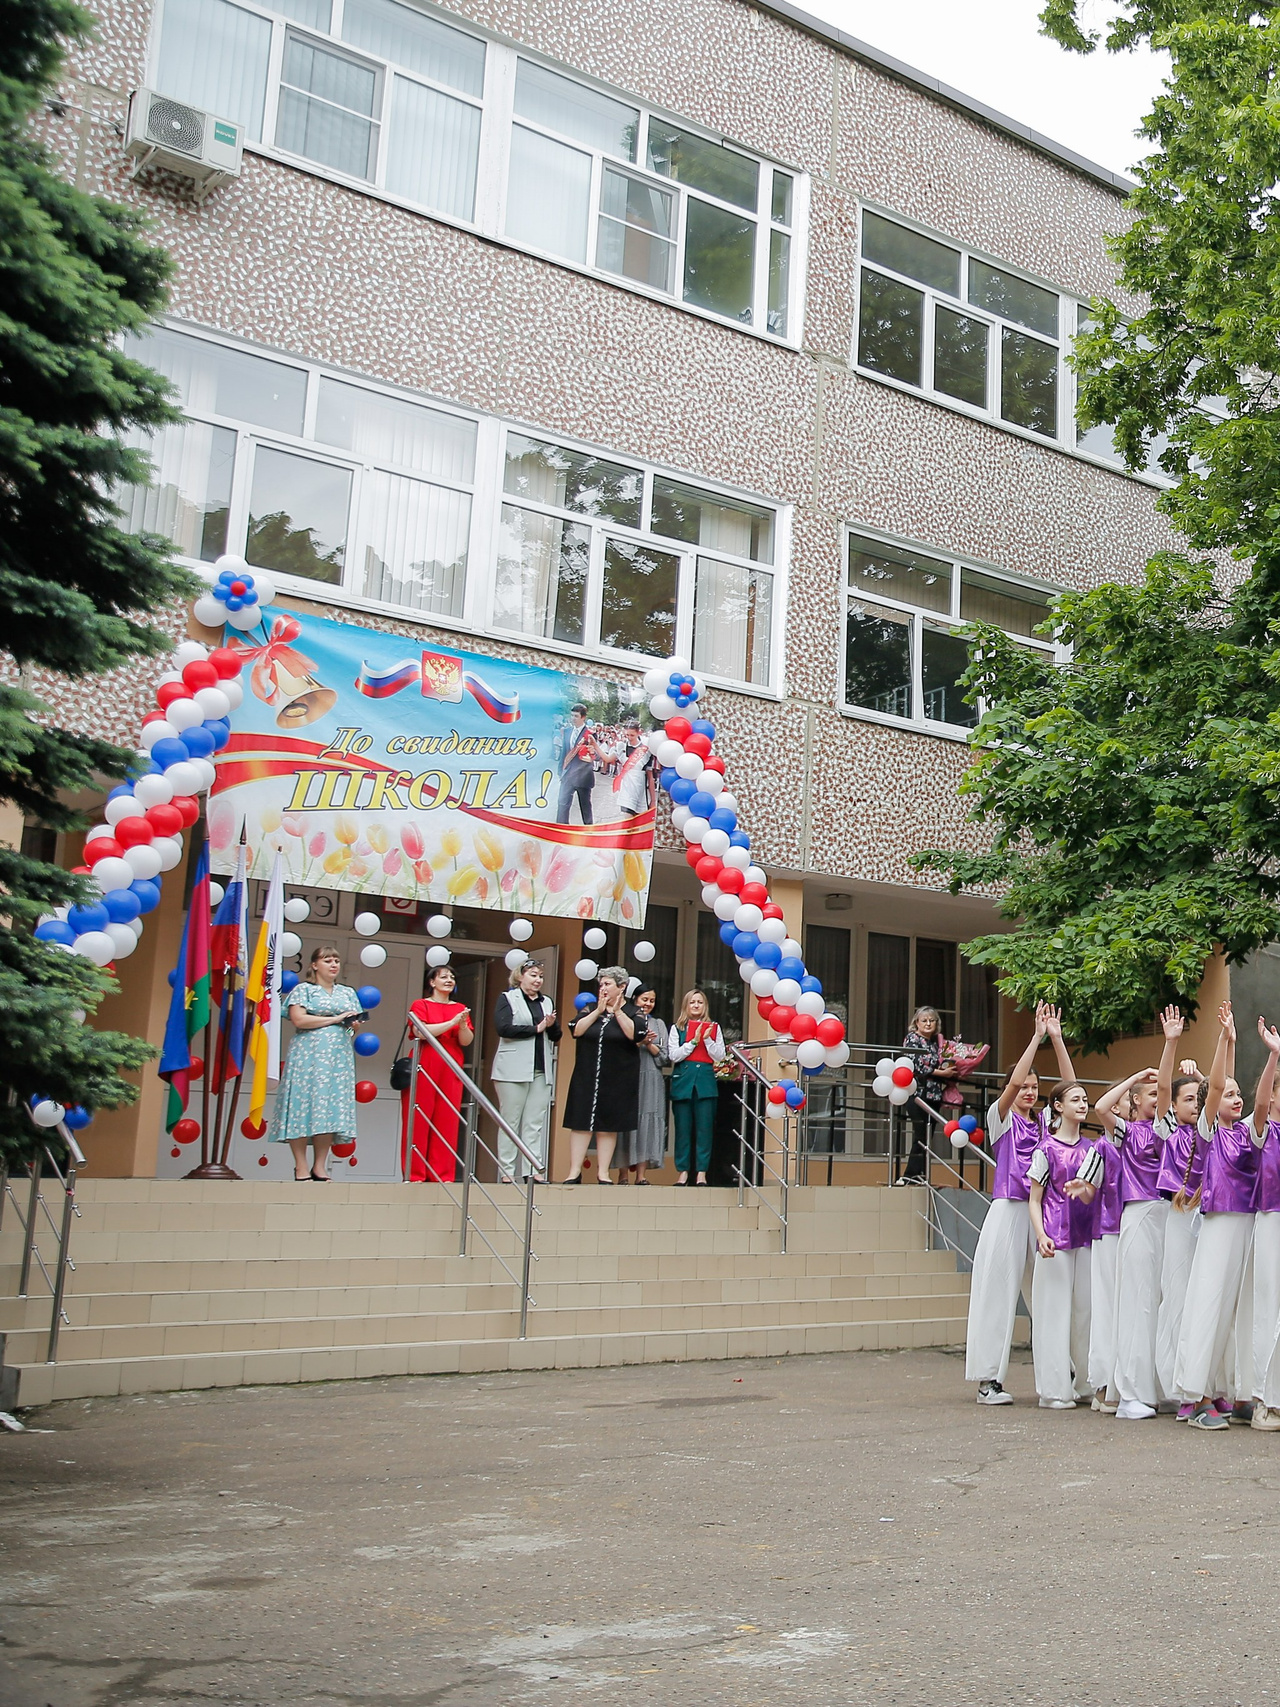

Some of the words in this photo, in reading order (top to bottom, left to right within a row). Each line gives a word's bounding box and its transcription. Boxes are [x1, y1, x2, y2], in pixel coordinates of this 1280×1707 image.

[318, 727, 373, 759] До
[386, 729, 537, 760] свидания,
[283, 770, 553, 811] ШКОЛА!
